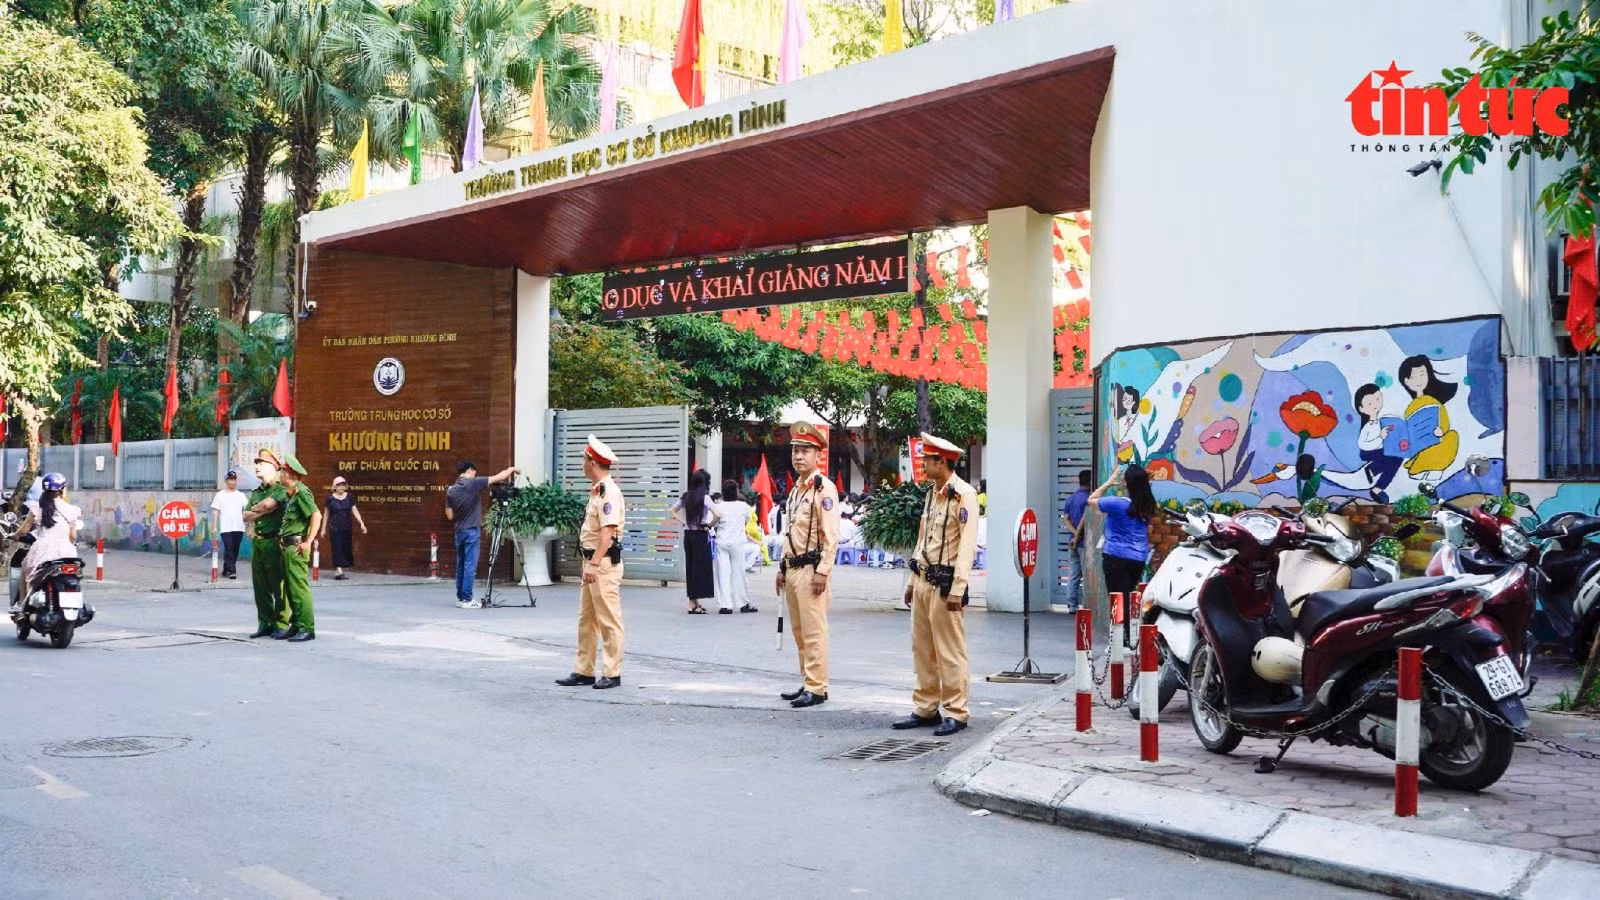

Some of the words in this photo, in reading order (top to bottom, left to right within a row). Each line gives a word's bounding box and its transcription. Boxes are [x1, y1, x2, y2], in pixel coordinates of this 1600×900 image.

[464, 169, 516, 200] TRƯỜNG
[520, 156, 567, 186] TRUNG
[571, 147, 603, 176] HỌC
[606, 138, 629, 166] CƠ
[632, 124, 656, 159] SỞ
[659, 113, 734, 154] KHƯƠNG
[738, 99, 787, 133] ĐÌNH
[667, 275, 698, 303] VÀ
[758, 263, 831, 294] GIẢNG
[834, 255, 893, 286] NĂM
[329, 407, 368, 421] TRƯỜNG
[369, 410, 401, 421] TRUNG
[401, 409, 421, 423] HỌC
[422, 408, 437, 420] CƠ
[438, 404, 452, 420] SỞ
[329, 430, 402, 451] KHƯƠNG
[405, 426, 451, 451] ĐÌNH
[339, 461, 357, 472] ĐẠT
[360, 456, 391, 471] CHUẨN
[393, 457, 420, 471] QUỐC
[422, 461, 440, 471] GIA
[162, 505, 190, 519] CẤM
[163, 520, 176, 532] ĐỖ
[178, 523, 190, 532] XE
[1021, 518, 1036, 542] CẤM
